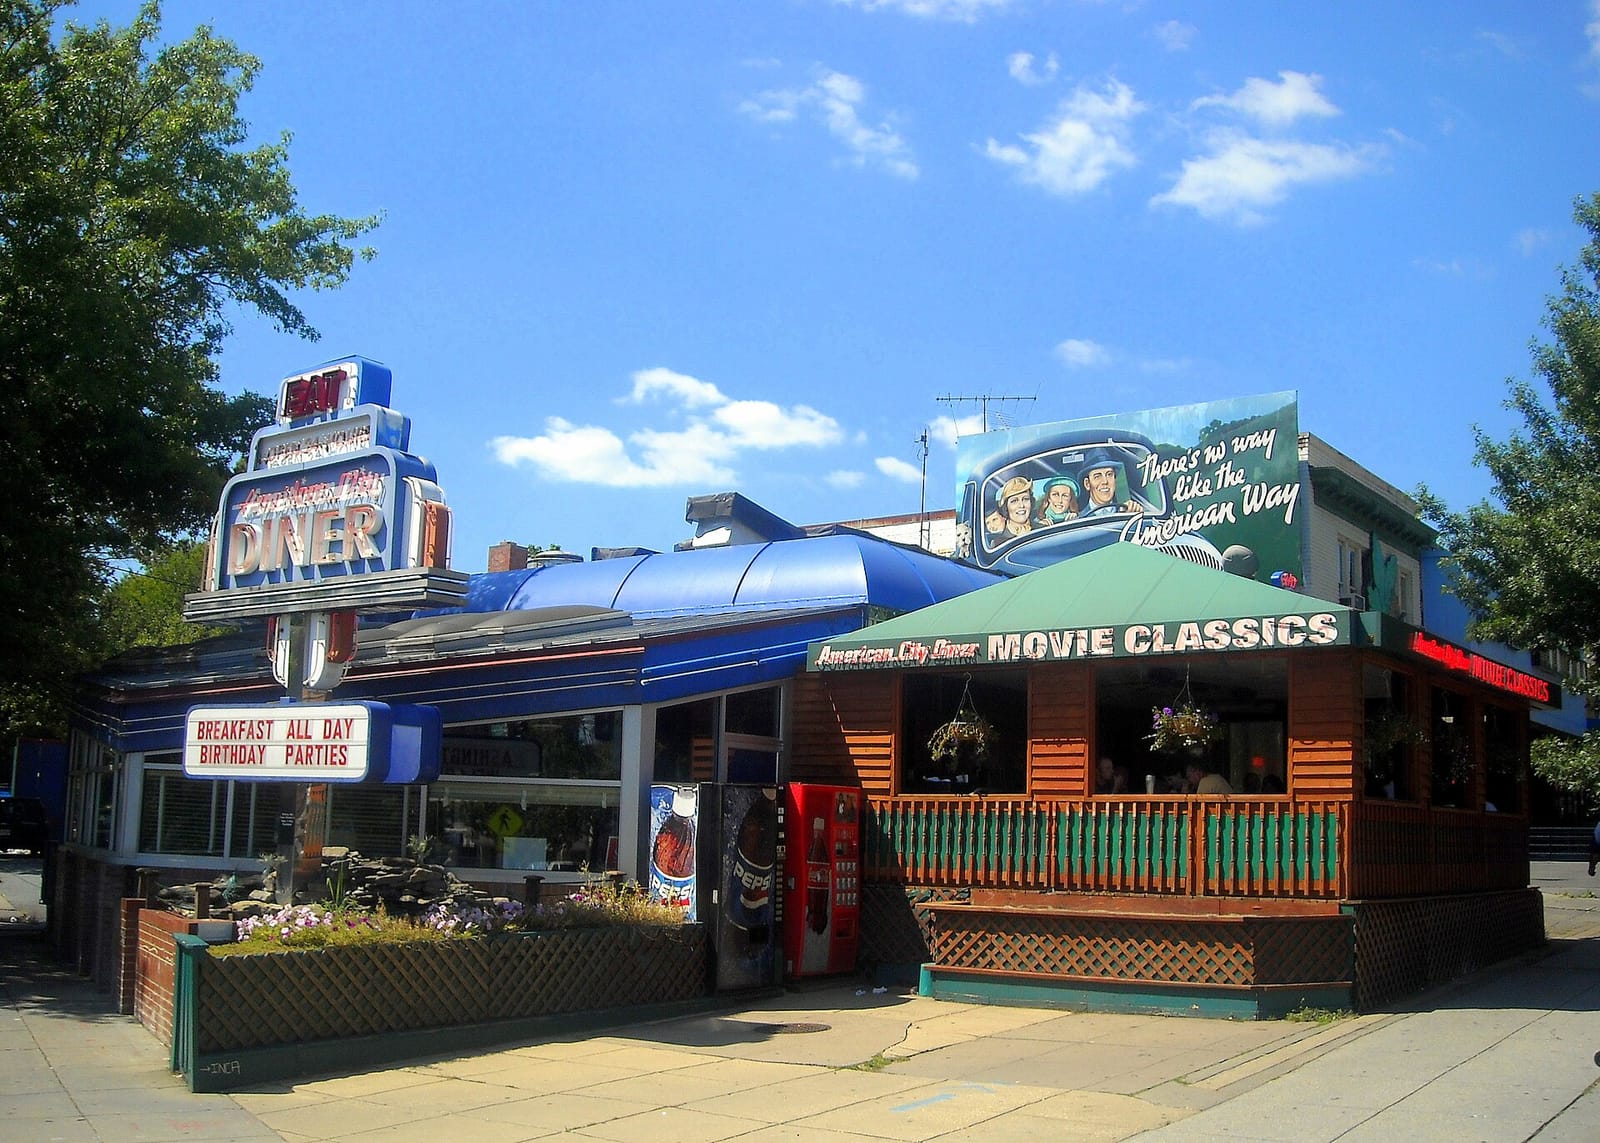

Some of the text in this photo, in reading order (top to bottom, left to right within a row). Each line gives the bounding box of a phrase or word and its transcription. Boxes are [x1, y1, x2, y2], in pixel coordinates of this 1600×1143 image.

[283, 369, 347, 418] EAT
[1136, 429, 1276, 487] There's no way
[1173, 461, 1246, 502] like the
[1119, 483, 1300, 546] American Way
[227, 504, 384, 576] DINER
[814, 613, 1338, 665] American City Diner MOVIE CLASSICS
[1506, 668, 1549, 702] CLASSICS
[197, 718, 354, 740] BREAKFAST ALL DAY
[199, 744, 348, 766] BIRTHDAY PARTIES
[651, 873, 693, 901] PEPSI
